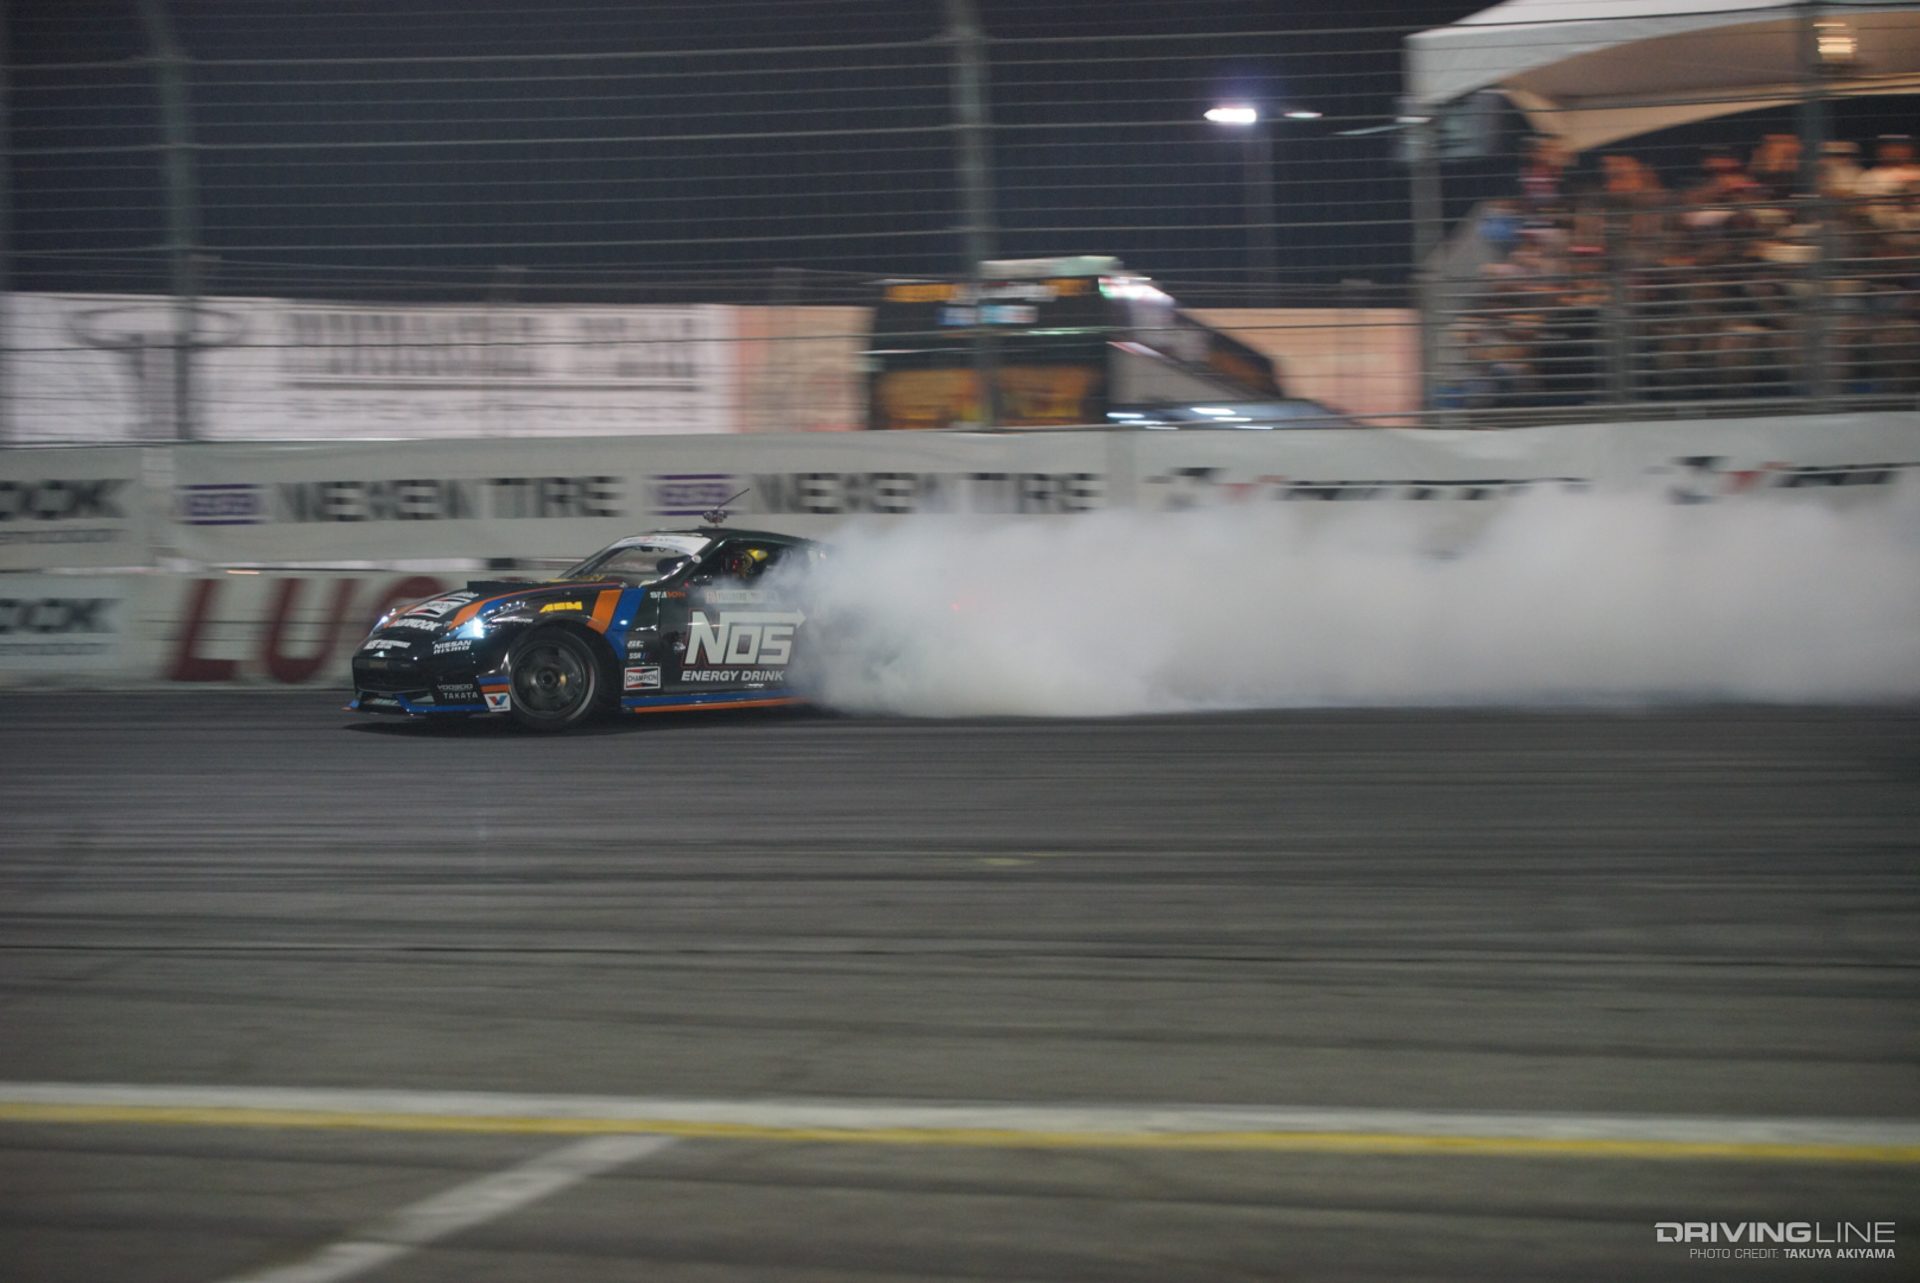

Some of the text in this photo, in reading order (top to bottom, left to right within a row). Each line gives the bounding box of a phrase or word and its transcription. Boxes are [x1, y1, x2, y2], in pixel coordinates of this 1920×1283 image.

[539, 602, 583, 613] AEM
[685, 611, 805, 665] NOS
[433, 640, 472, 650] NISSAN
[627, 674, 658, 683] CHAMPION
[681, 670, 785, 682] ENERGY DRINK
